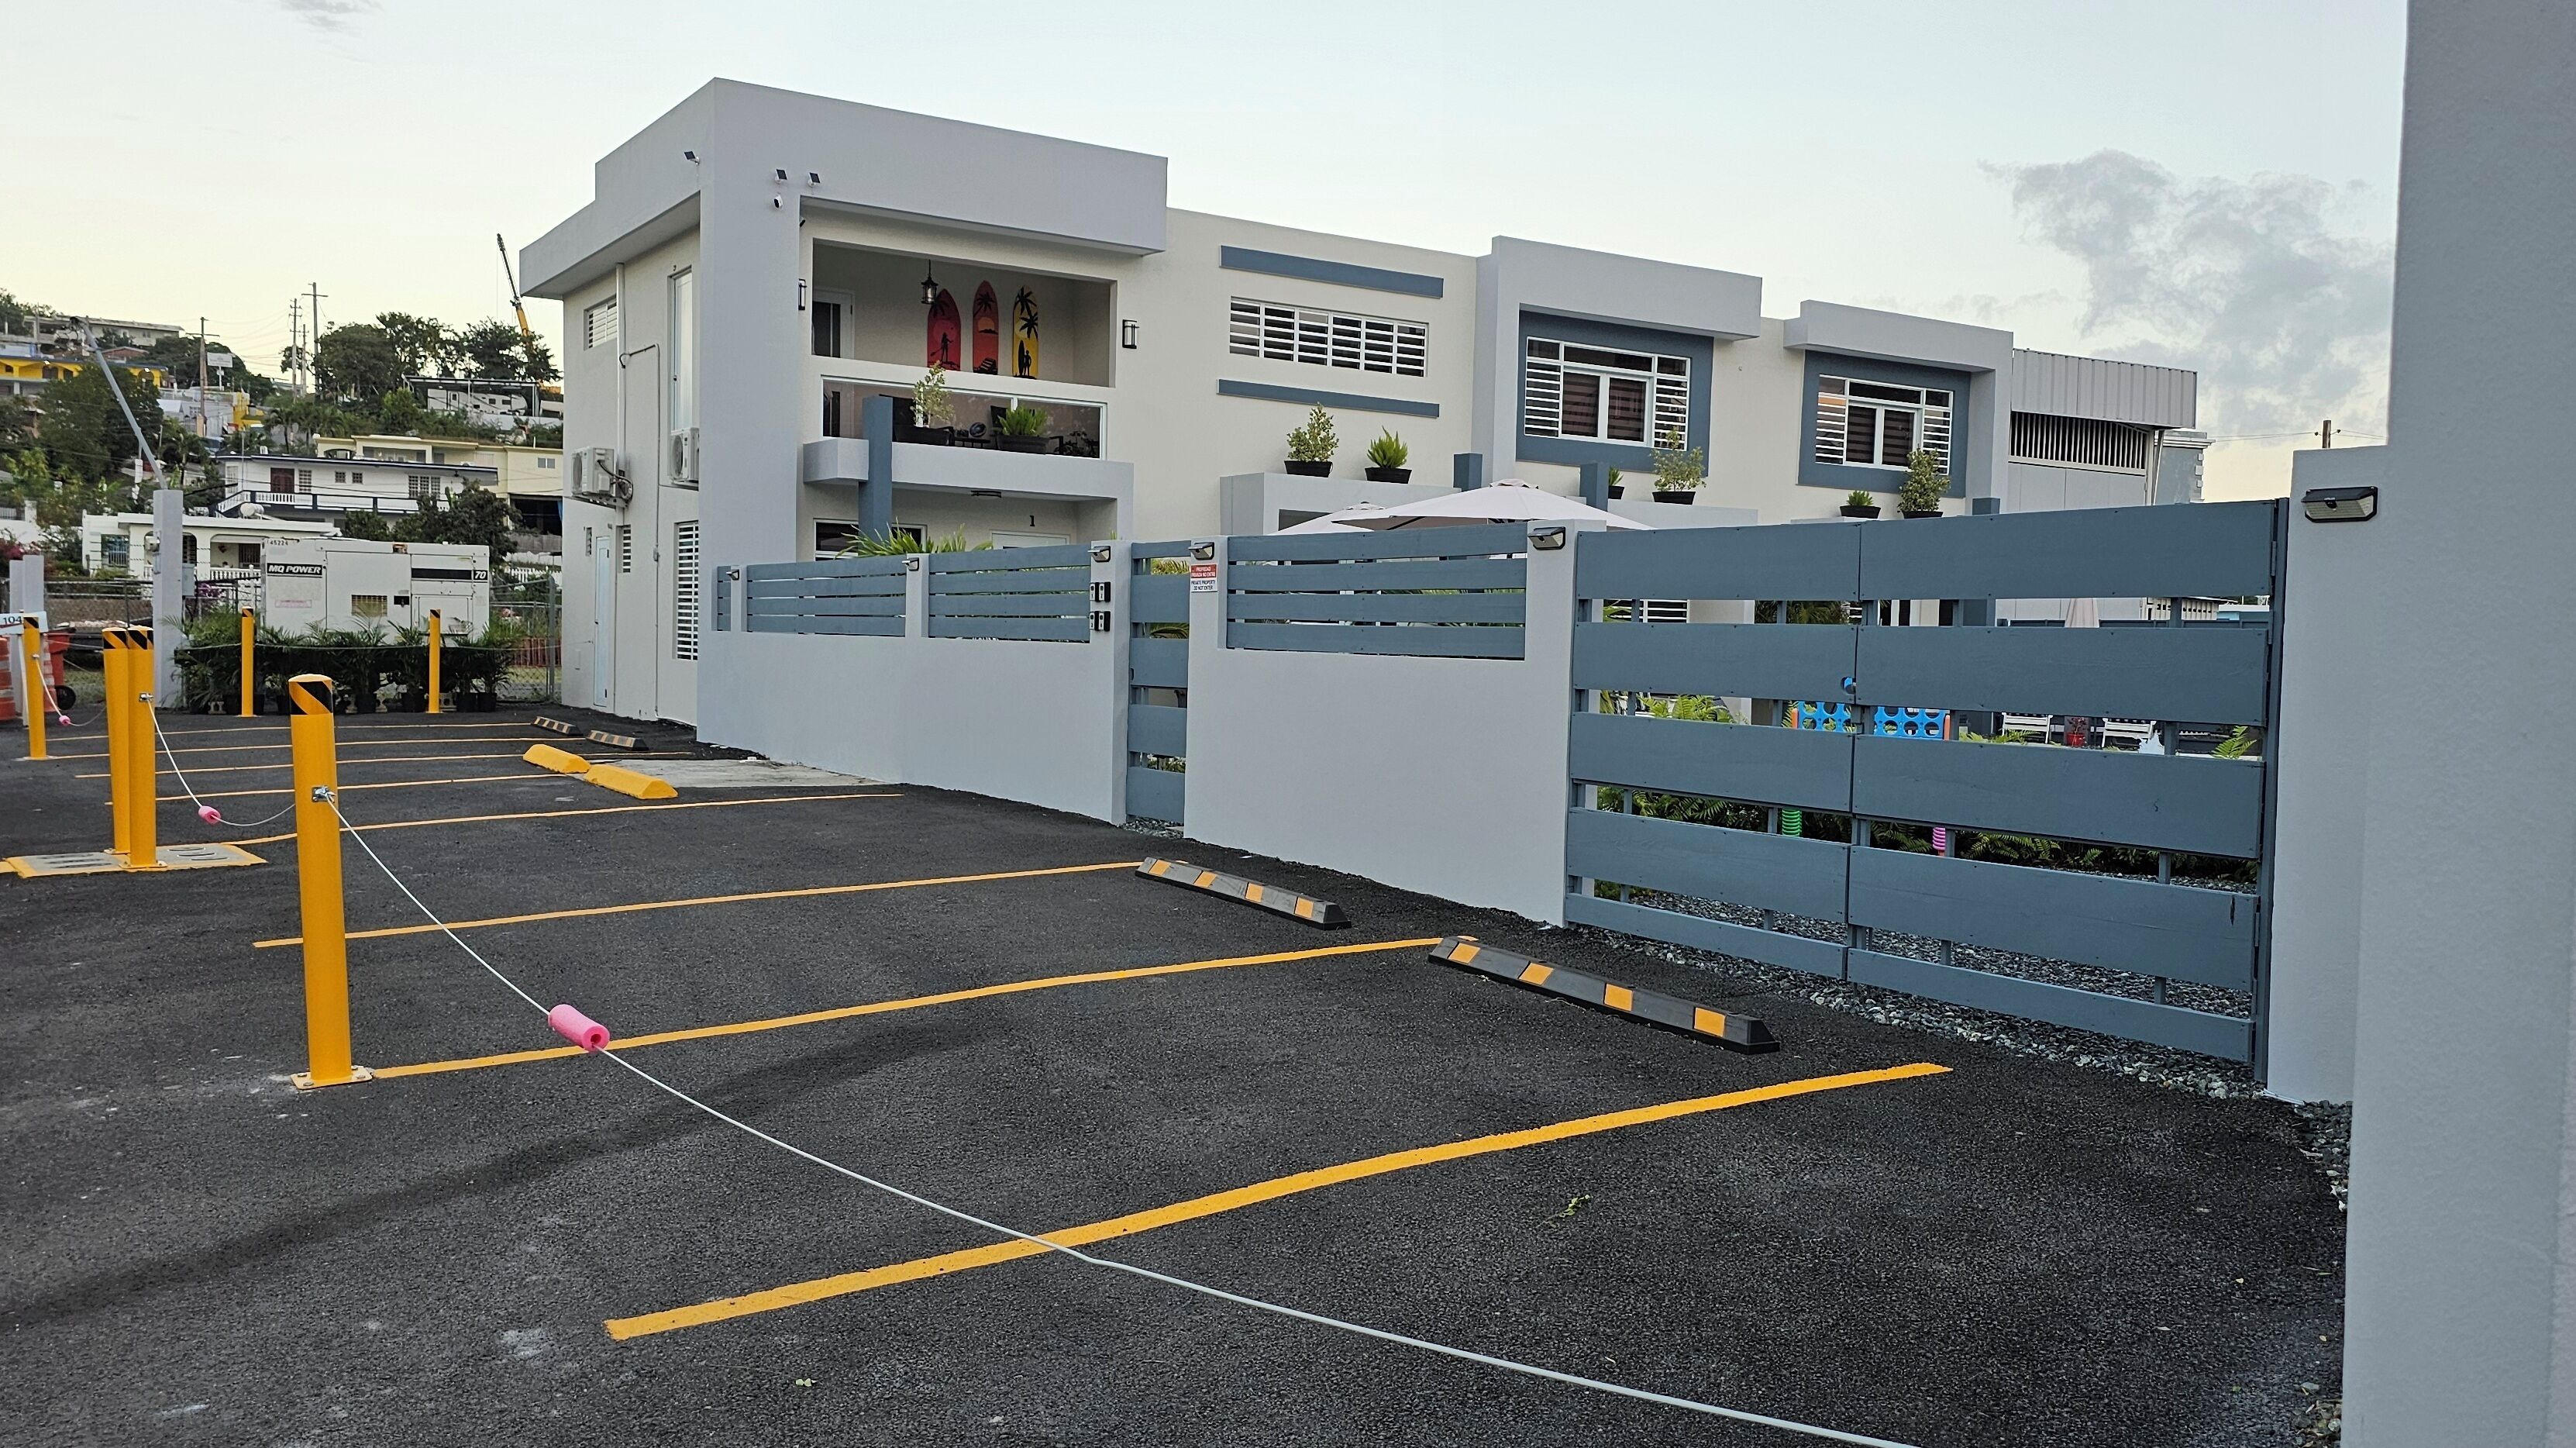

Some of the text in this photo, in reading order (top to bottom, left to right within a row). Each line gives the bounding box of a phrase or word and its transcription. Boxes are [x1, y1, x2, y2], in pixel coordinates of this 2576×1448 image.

[1029, 515, 1035, 527] 1
[268, 564, 322, 574] MQ POWER
[474, 571, 487, 579] 70
[3, 616, 22, 625] 104
